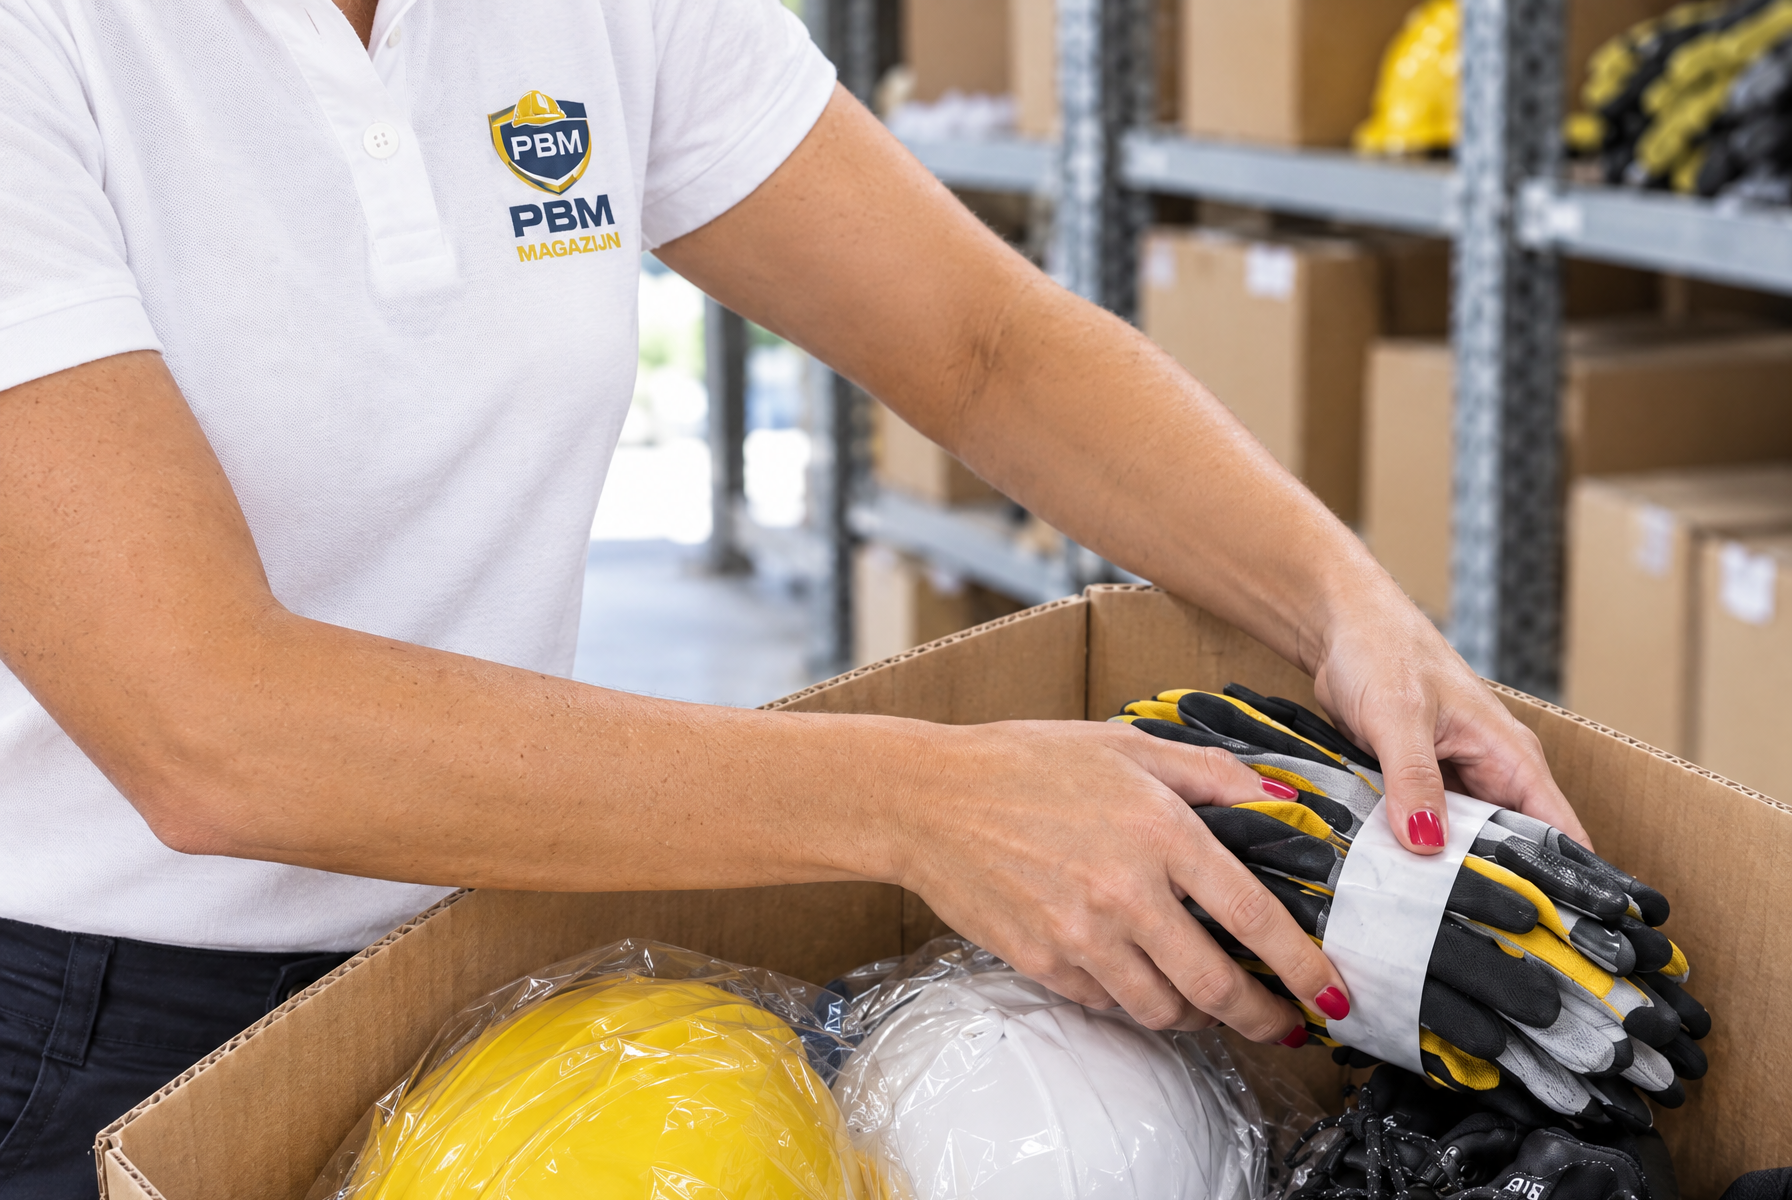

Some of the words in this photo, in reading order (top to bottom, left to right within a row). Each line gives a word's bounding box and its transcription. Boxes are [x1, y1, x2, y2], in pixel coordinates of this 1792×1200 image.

[511, 129, 583, 160] PBM
[509, 194, 615, 238] PBM
[517, 232, 621, 262] MAGAZIJN
